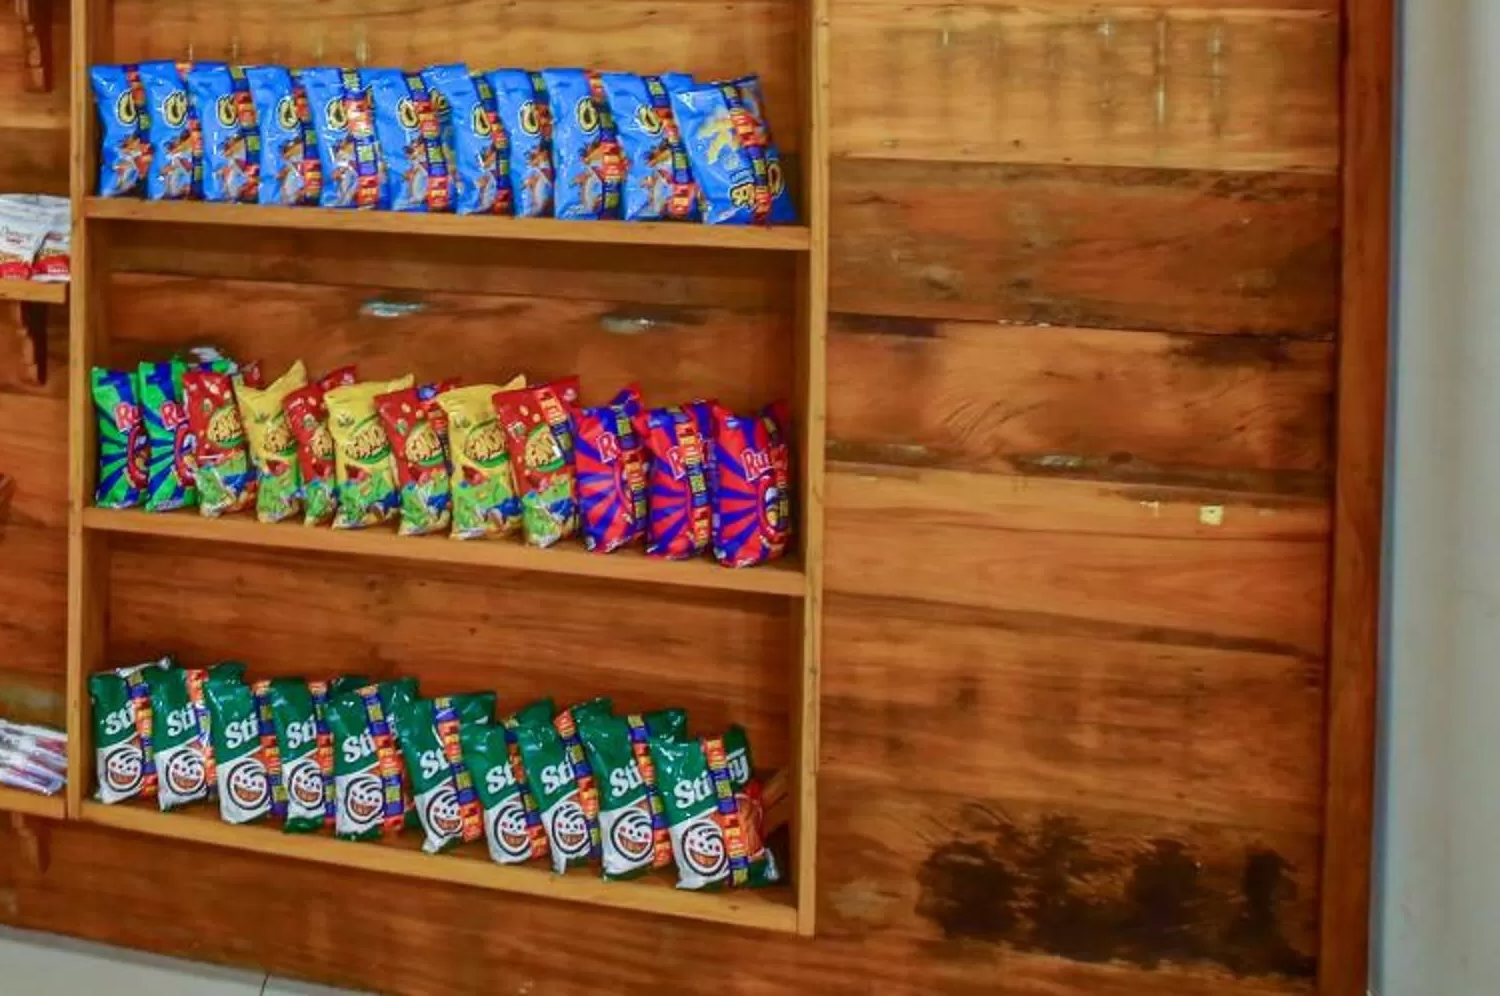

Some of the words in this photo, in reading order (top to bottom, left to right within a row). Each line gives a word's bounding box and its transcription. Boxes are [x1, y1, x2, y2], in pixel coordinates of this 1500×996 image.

[105, 702, 136, 737] Sti
[166, 702, 198, 737] Sti
[225, 710, 260, 749] Sti
[285, 714, 318, 749] Sti
